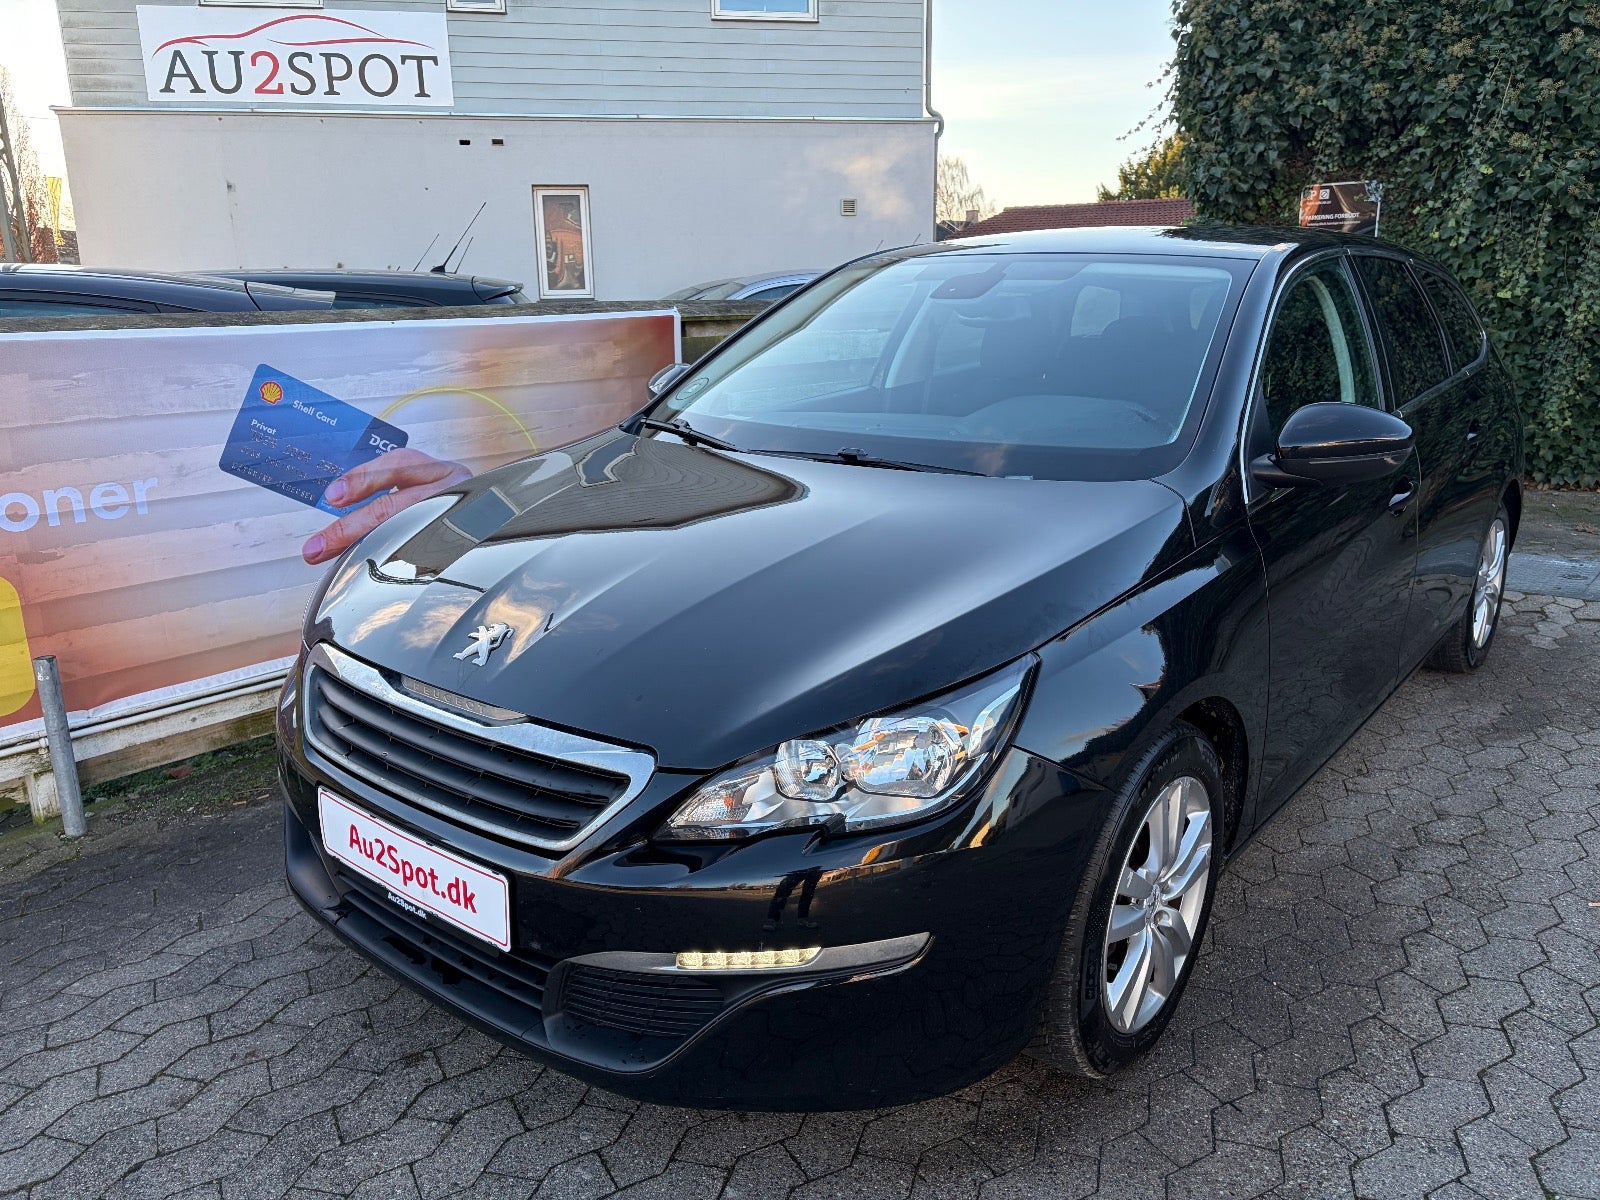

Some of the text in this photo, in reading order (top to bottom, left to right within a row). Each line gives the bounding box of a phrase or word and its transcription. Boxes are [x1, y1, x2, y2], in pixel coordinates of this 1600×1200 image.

[160, 49, 439, 99] AU2SPOT
[251, 418, 277, 435] Privat
[292, 399, 338, 427] Shell Card
[349, 823, 477, 914] Au2Spot.dk
[387, 891, 428, 919] Au2Spot.dk
